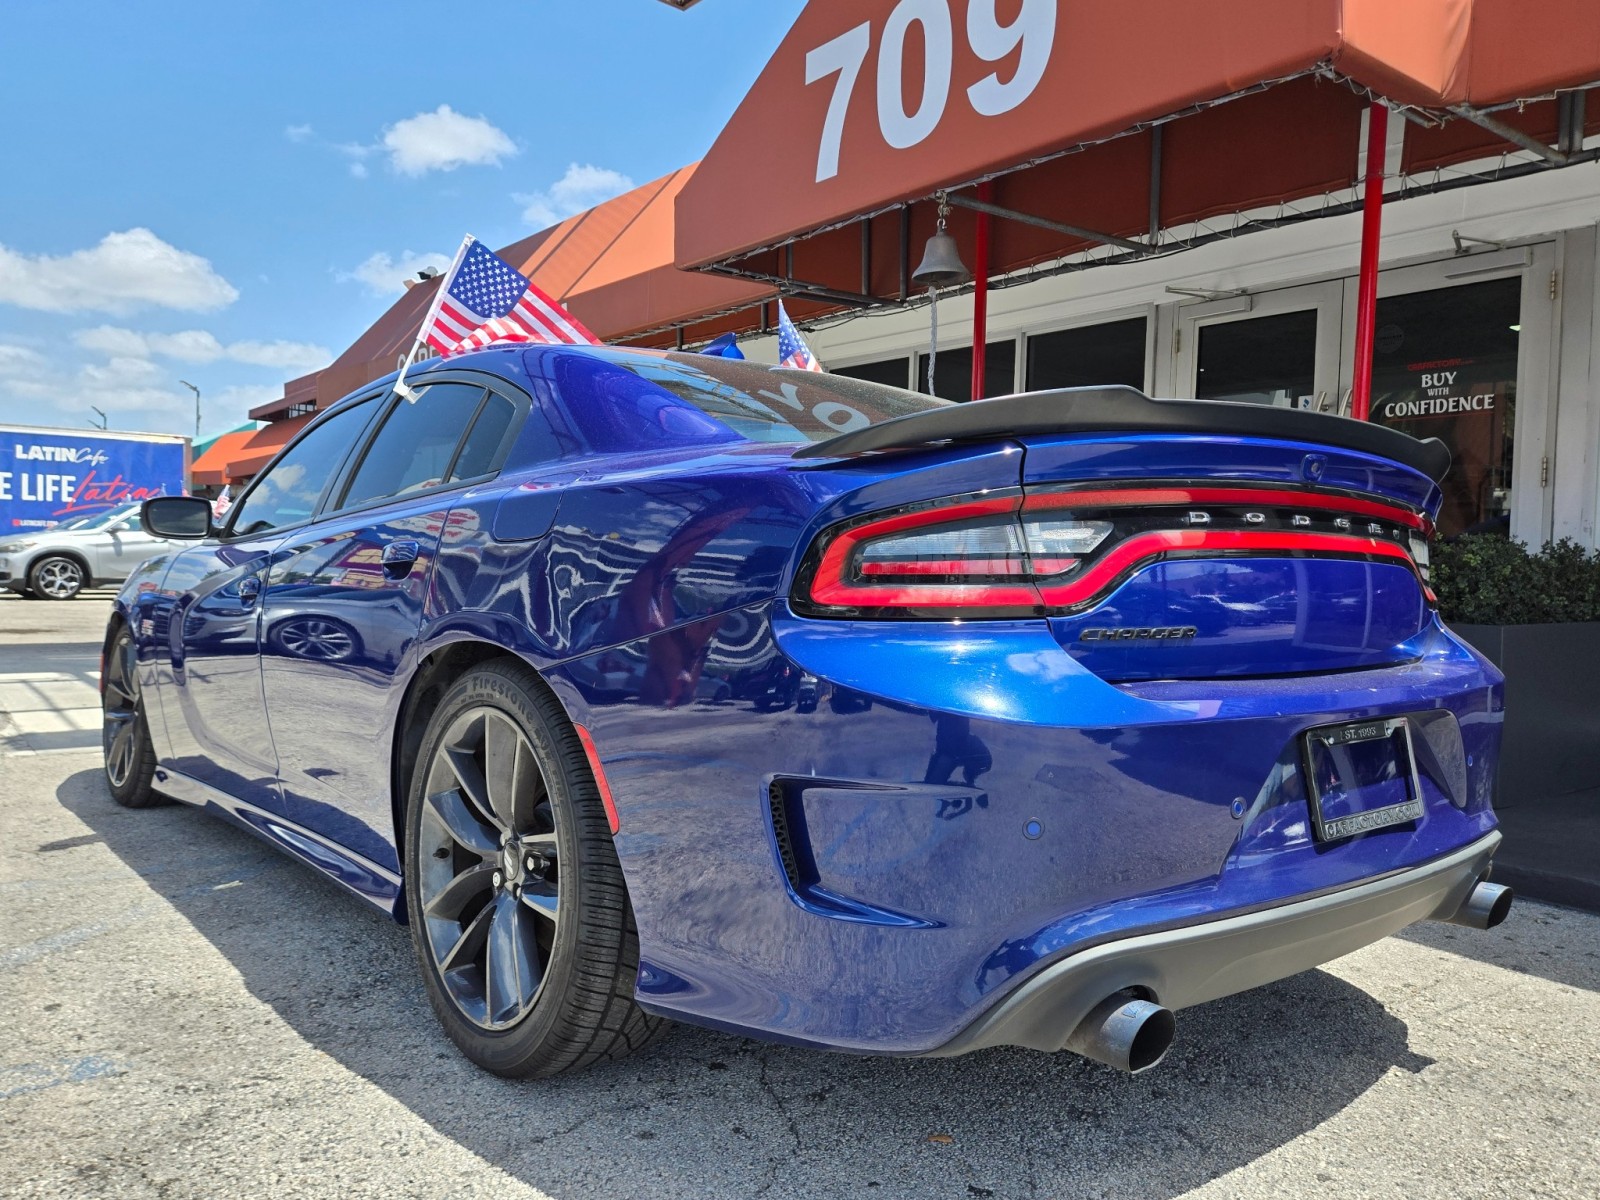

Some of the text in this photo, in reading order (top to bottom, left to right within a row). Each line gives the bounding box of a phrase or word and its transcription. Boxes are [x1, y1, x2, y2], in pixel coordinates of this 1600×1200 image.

[805, 0, 1057, 183] 709
[1421, 371, 1457, 388] BUY
[1427, 387, 1450, 397] WITH
[1385, 393, 1494, 417] CONFIDENCE
[15, 444, 76, 463] LATIN
[21, 473, 77, 502] LIFE
[1187, 510, 1385, 536] DODGE
[1080, 625, 1198, 641] CHARGER
[472, 676, 535, 725] Firestone
[1358, 726, 1376, 738] 1993
